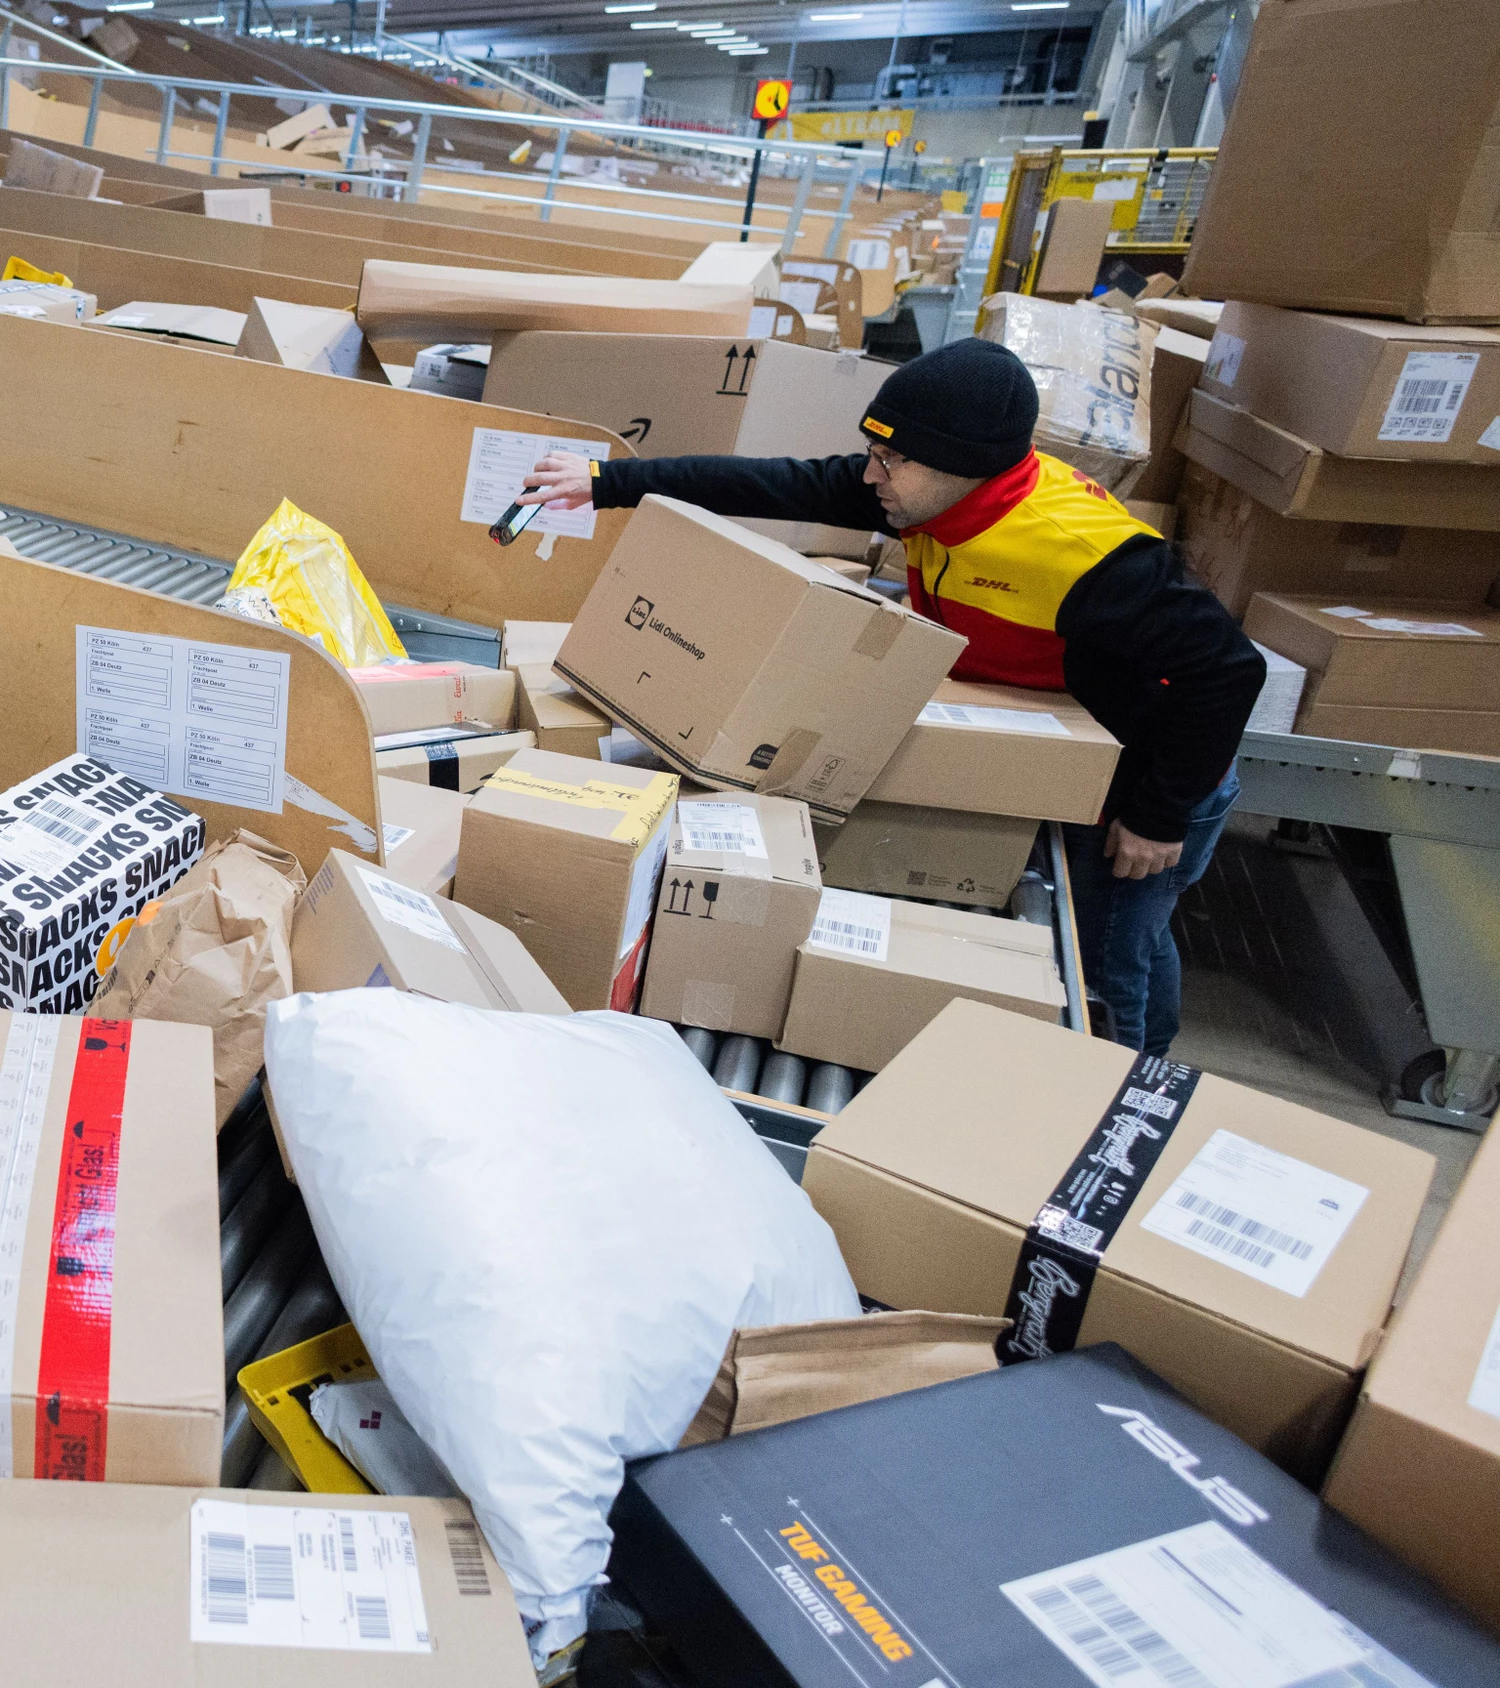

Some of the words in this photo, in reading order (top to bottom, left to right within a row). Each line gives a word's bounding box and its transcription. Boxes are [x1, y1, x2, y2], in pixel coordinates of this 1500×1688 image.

[869, 421, 887, 433] DHL
[970, 577, 1013, 592] DHL
[107, 640, 119, 648] Köln
[649, 617, 664, 633] Lidl
[663, 627, 705, 661] Onlineshop
[91, 649, 114, 657] Frachtpost
[107, 662, 122, 670] Deutz
[193, 665, 217, 674] Frachtpost
[210, 680, 226, 688] Deutz
[90, 724, 113, 732] Frachtpost
[106, 737, 120, 745] Deutz
[207, 734, 220, 742] Köln
[190, 743, 214, 751] Frachtpost
[206, 756, 222, 765] Deutz
[674, 839, 684, 856] fragile
[12, 822, 150, 911] SNACKS
[803, 858, 814, 876] fragile
[75, 1143, 105, 1180] Glas!
[51, 1433, 88, 1482] Glas!
[1095, 1402, 1270, 1527] ASUS
[399, 1520, 409, 1538] DHL
[402, 1540, 414, 1567] PAKET
[779, 1520, 828, 1564] TUF
[814, 1563, 913, 1662] GAMING
[773, 1564, 843, 1636] MONITOR
